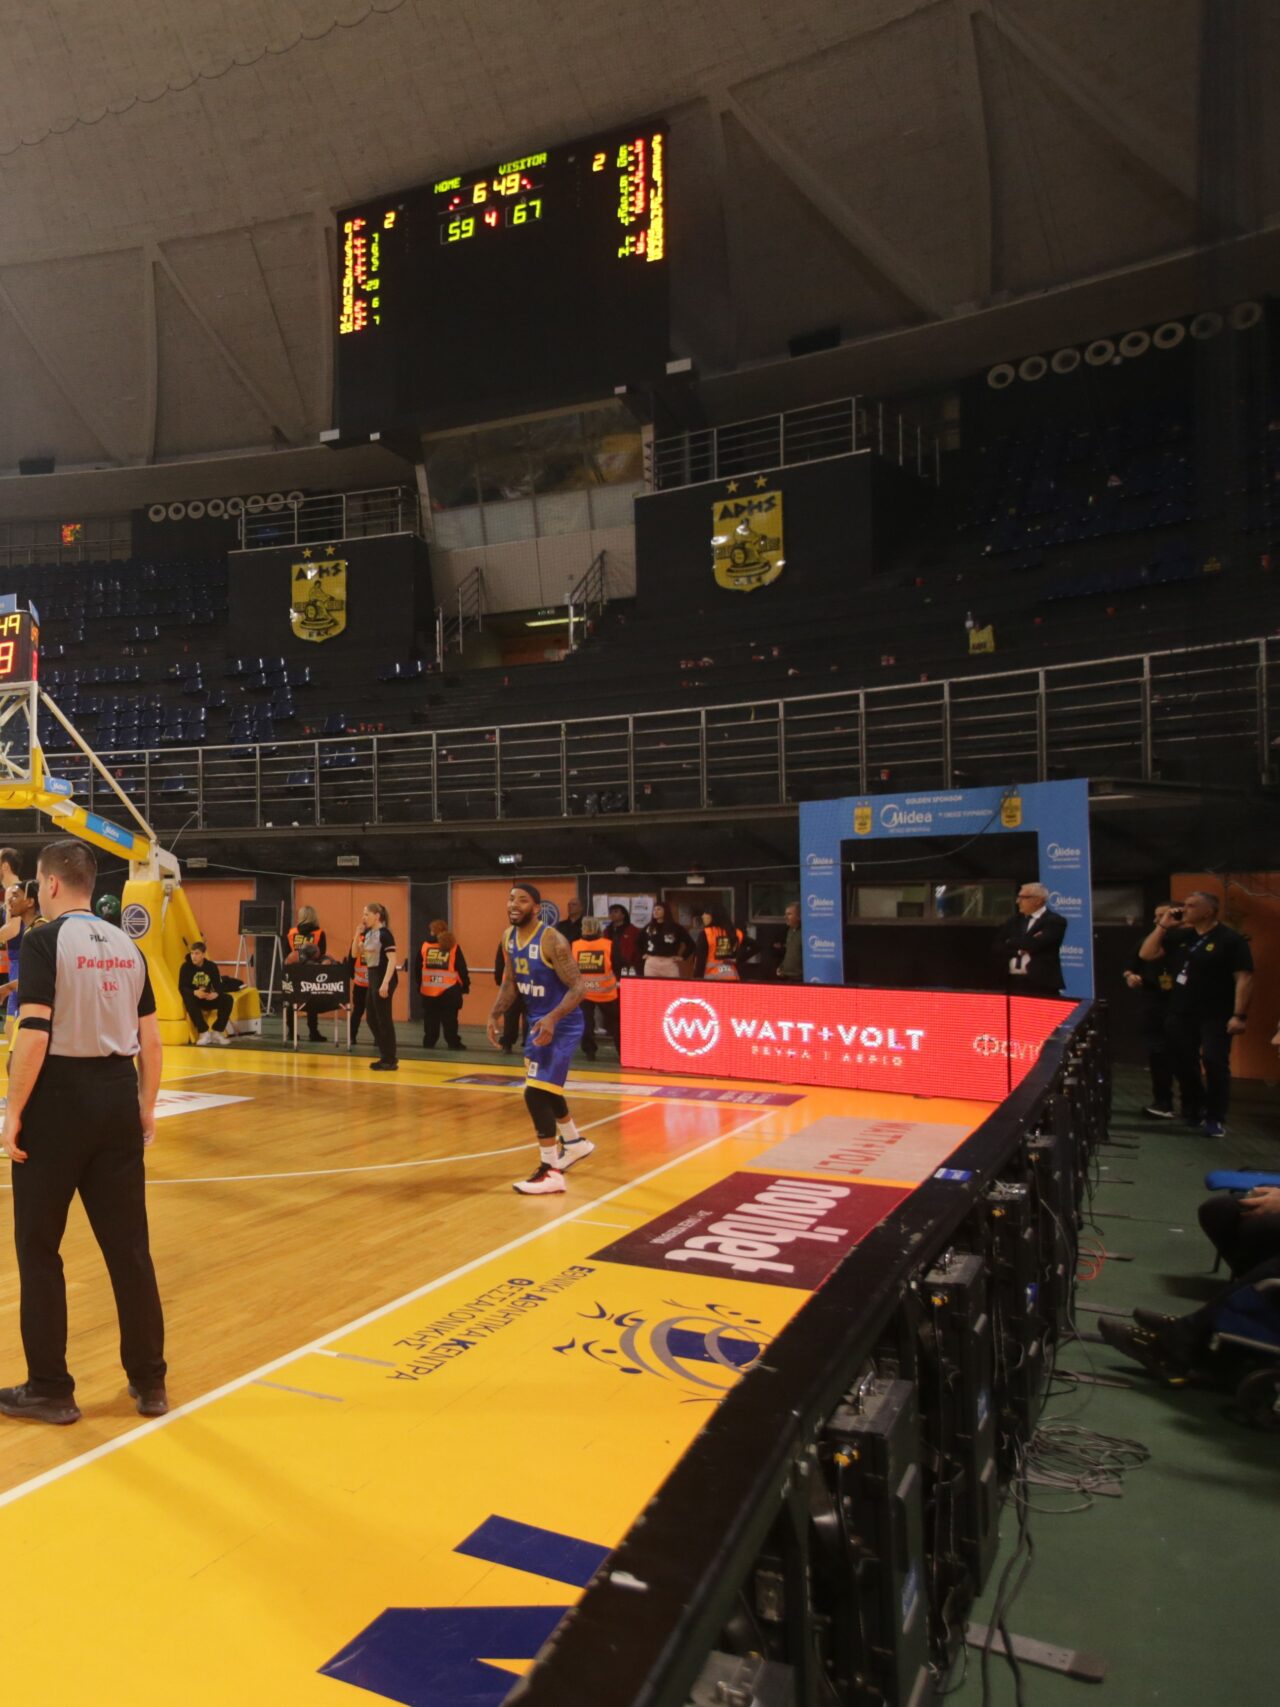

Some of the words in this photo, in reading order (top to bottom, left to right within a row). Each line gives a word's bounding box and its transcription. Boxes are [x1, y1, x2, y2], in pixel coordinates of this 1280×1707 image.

[499, 152, 547, 175] VISITOR
[592, 153, 606, 172] 2
[434, 177, 461, 194] HOME
[473, 182, 487, 203] 6
[493, 173, 520, 196] 49
[383, 211, 396, 229] 2
[484, 210, 497, 228] 4
[513, 199, 542, 225] 67
[448, 217, 474, 243] 59
[881, 804, 933, 828] Midea
[1047, 843, 1080, 858] Midea
[1049, 892, 1081, 907] Midea
[89, 934, 108, 942] FILA
[514, 957, 529, 975] 12
[300, 981, 344, 993] SPALDING
[731, 1018, 924, 1050] WATT+VOLT
[664, 1179, 851, 1274] novibet
[386, 1337, 477, 1381] ΚΕΝΤΡΑ
